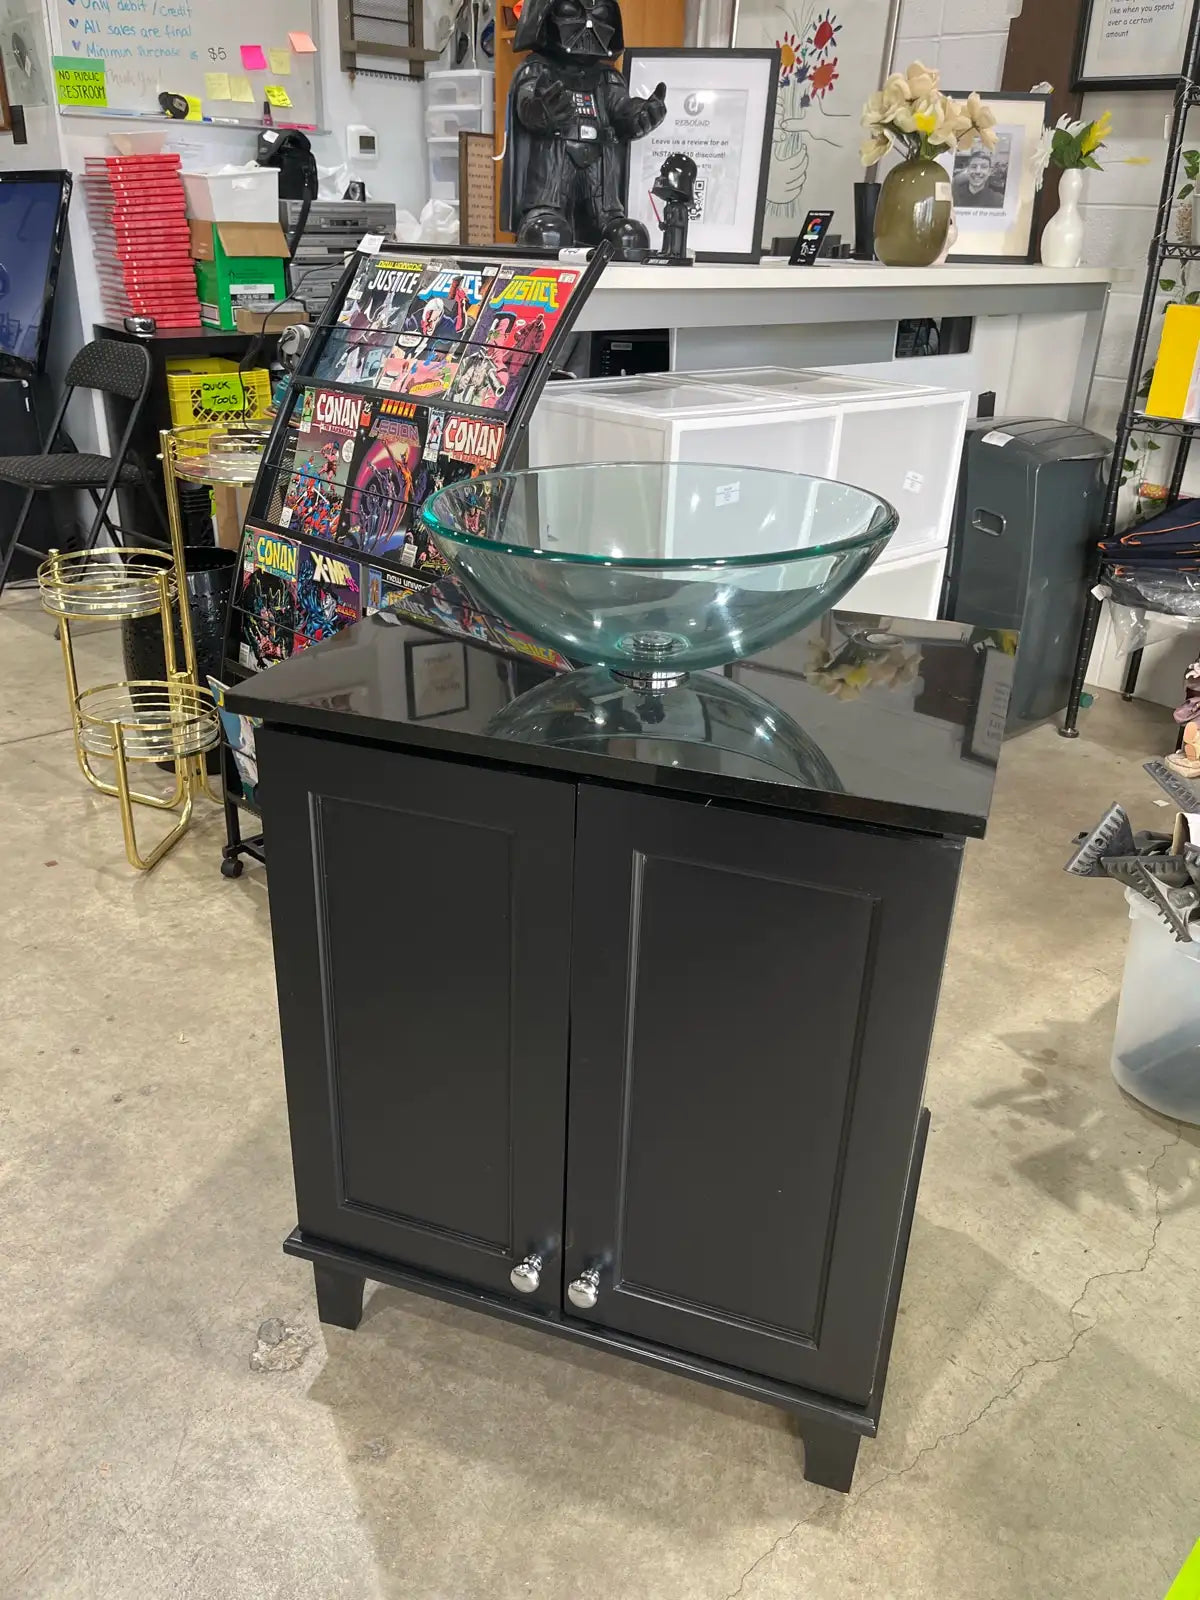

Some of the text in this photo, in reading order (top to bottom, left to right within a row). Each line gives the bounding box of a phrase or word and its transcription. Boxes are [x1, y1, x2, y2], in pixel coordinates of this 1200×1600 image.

[81, 0, 111, 13] Only
[117, 0, 147, 12] debit
[1109, 3, 1175, 16] like when you spend
[84, 19, 192, 39] All sales are final
[1107, 19, 1122, 27] over
[1128, 17, 1154, 25] certain
[1105, 30, 1129, 38] amount
[207, 47, 227, 62] $5
[59, 70, 101, 82] NO PUBLIC
[59, 85, 107, 99] RESTROOM
[675, 119, 711, 128] REBOUND
[695, 151, 726, 159] discount!
[368, 269, 421, 294] JUSTICE
[489, 275, 560, 313] JUSTICE
[316, 393, 362, 430] CONAN
[380, 399, 416, 419] ANNUAL
[368, 418, 419, 446] LEGION
[444, 418, 503, 460] CONAN
[256, 536, 297, 576] CONAN
[386, 573, 402, 585] new
